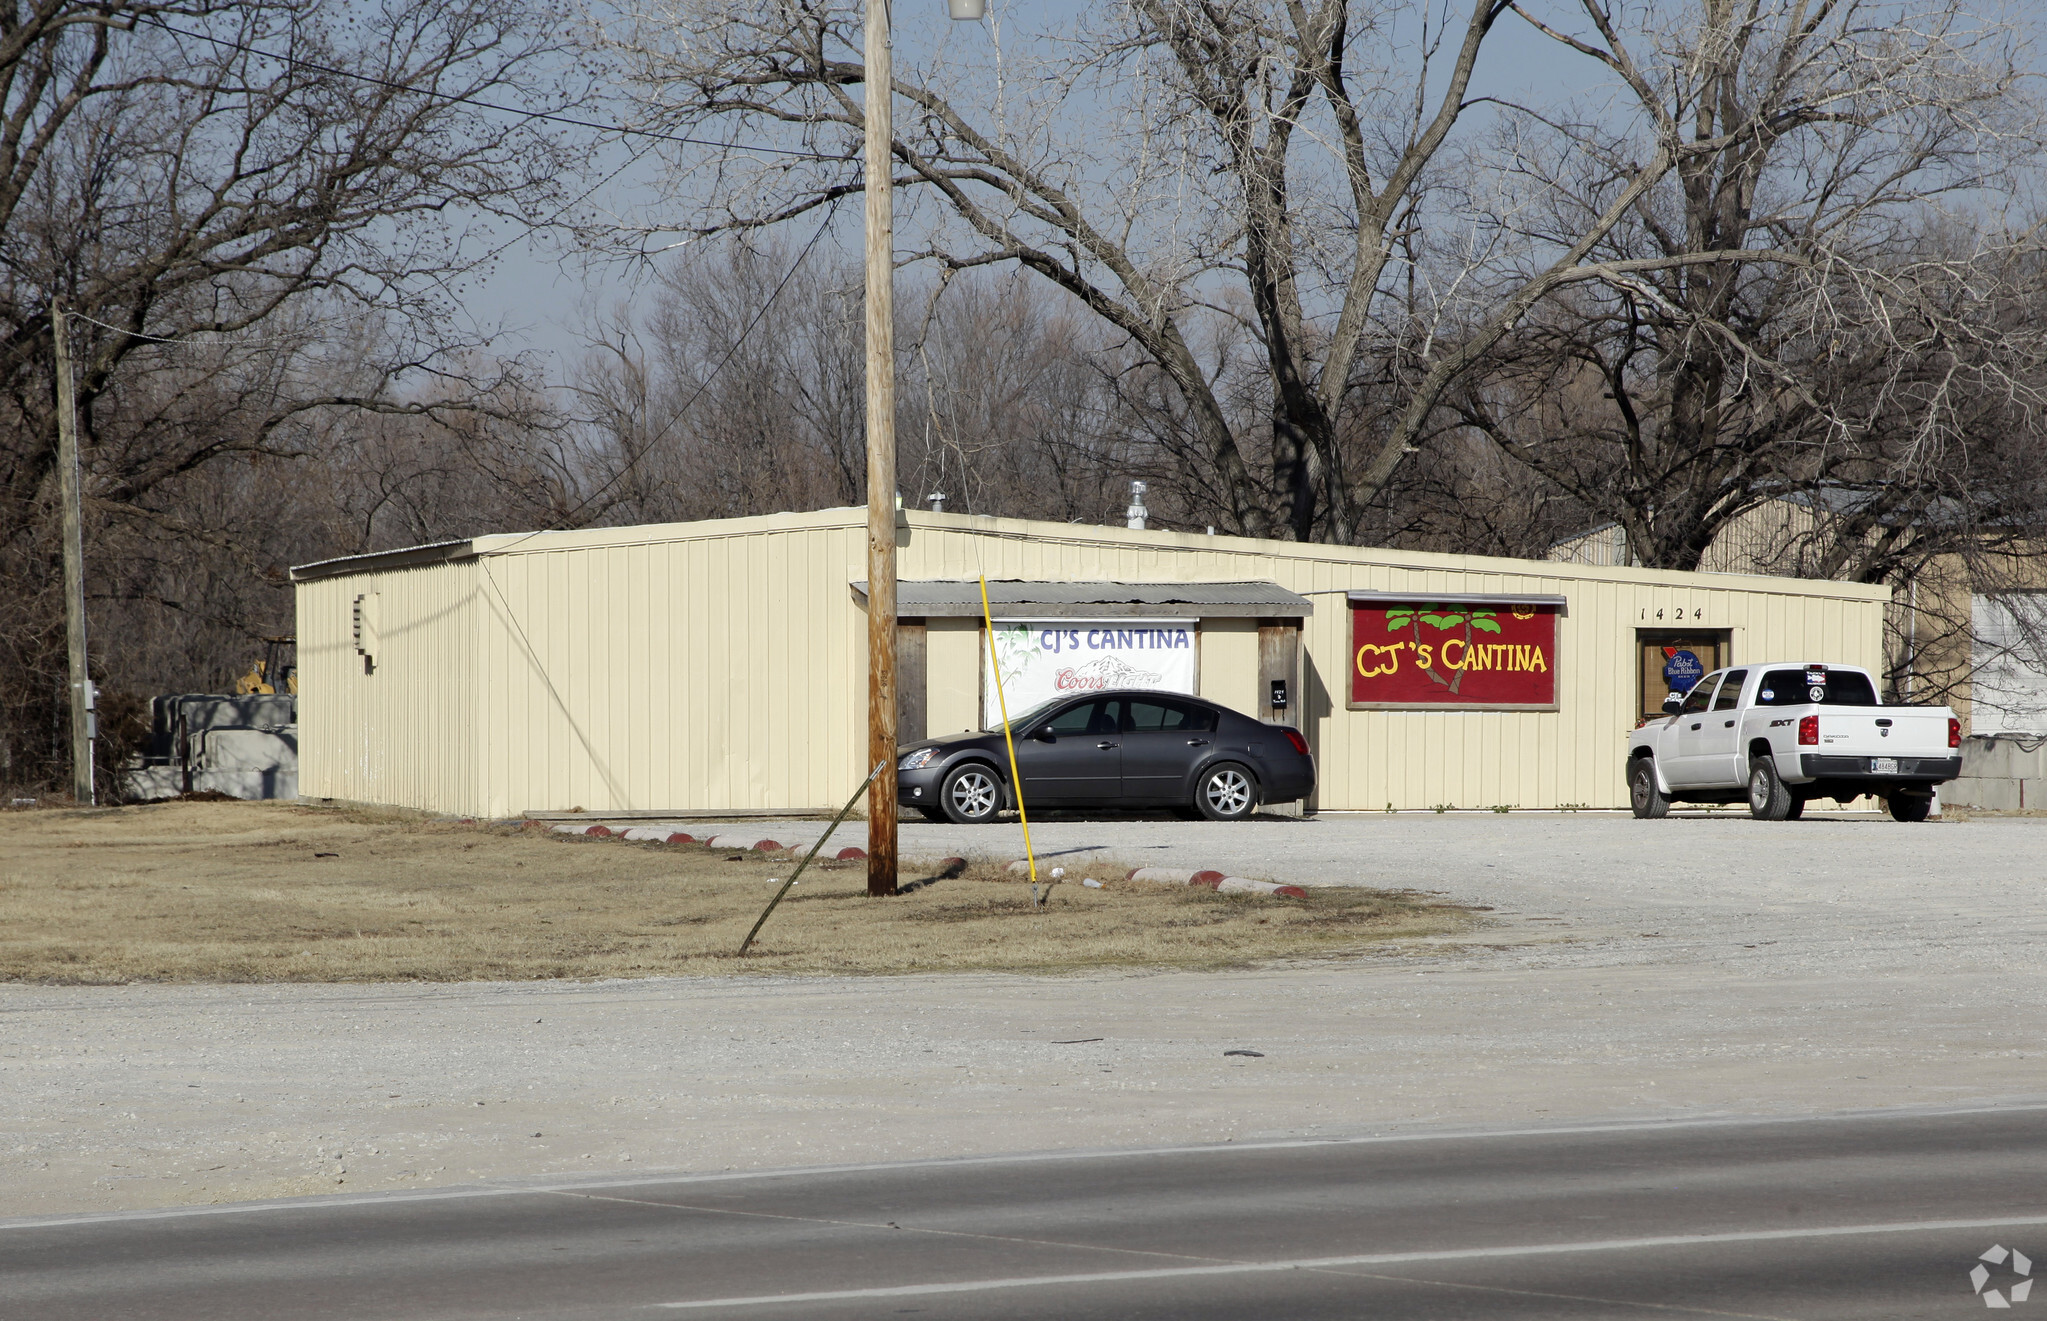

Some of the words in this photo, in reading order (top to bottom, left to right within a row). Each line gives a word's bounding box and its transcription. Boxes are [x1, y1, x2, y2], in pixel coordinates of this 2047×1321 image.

[1641, 608, 1702, 620] 1424
[1040, 628, 1080, 653] CJ'S
[1087, 628, 1190, 650] CANTINA
[1441, 639, 1548, 673] CANTINA
[1673, 655, 1694, 667] Pabst
[1668, 667, 1680, 675] Blue
[1681, 666, 1701, 675] Ribbon
[1056, 668, 1105, 690] Coors
[1769, 719, 1795, 727] SXT
